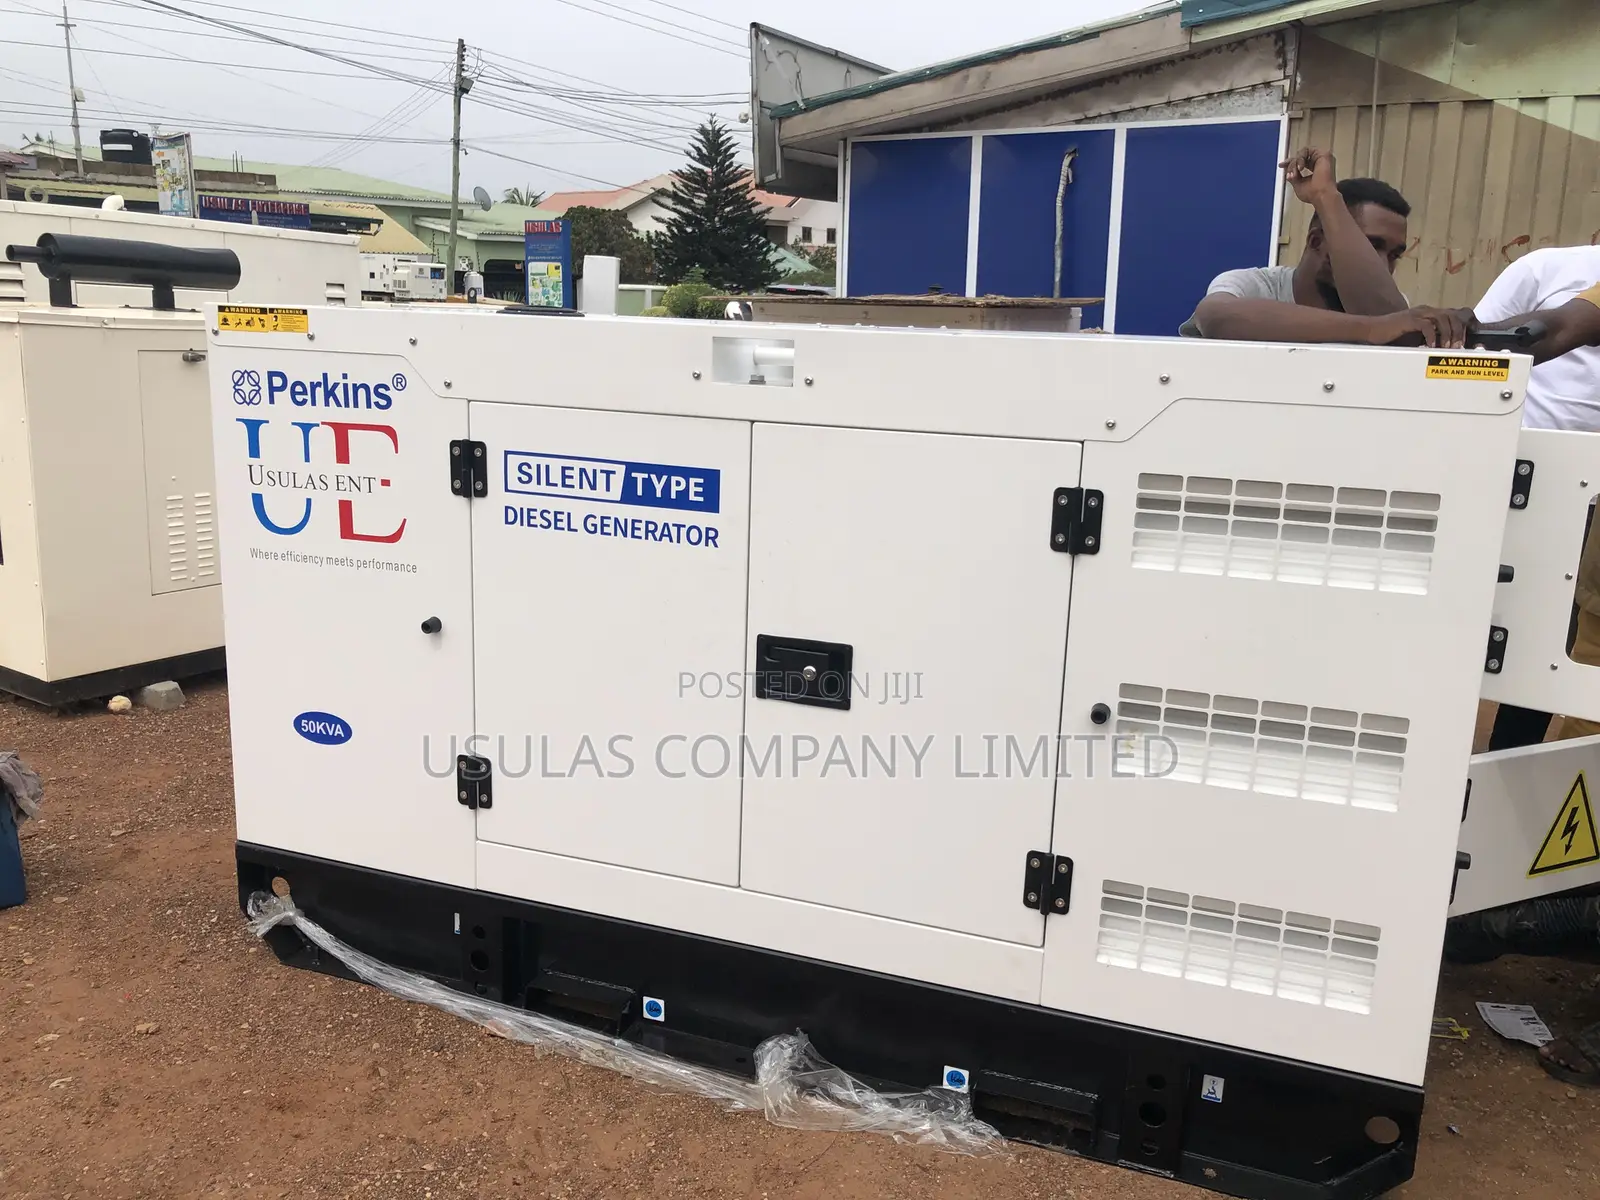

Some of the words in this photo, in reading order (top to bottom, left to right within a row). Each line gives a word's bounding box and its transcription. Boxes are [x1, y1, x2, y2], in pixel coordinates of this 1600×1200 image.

[1448, 359, 1499, 367] WARNING
[517, 462, 616, 492] SILENT
[631, 472, 704, 501] TYPE
[504, 505, 578, 532] DIESEL
[583, 514, 719, 548] GENERATOR
[250, 548, 279, 561] Where
[280, 551, 324, 567] efficiency
[326, 556, 354, 568] meets
[356, 558, 417, 573] performance
[301, 719, 344, 737] 50KVA
